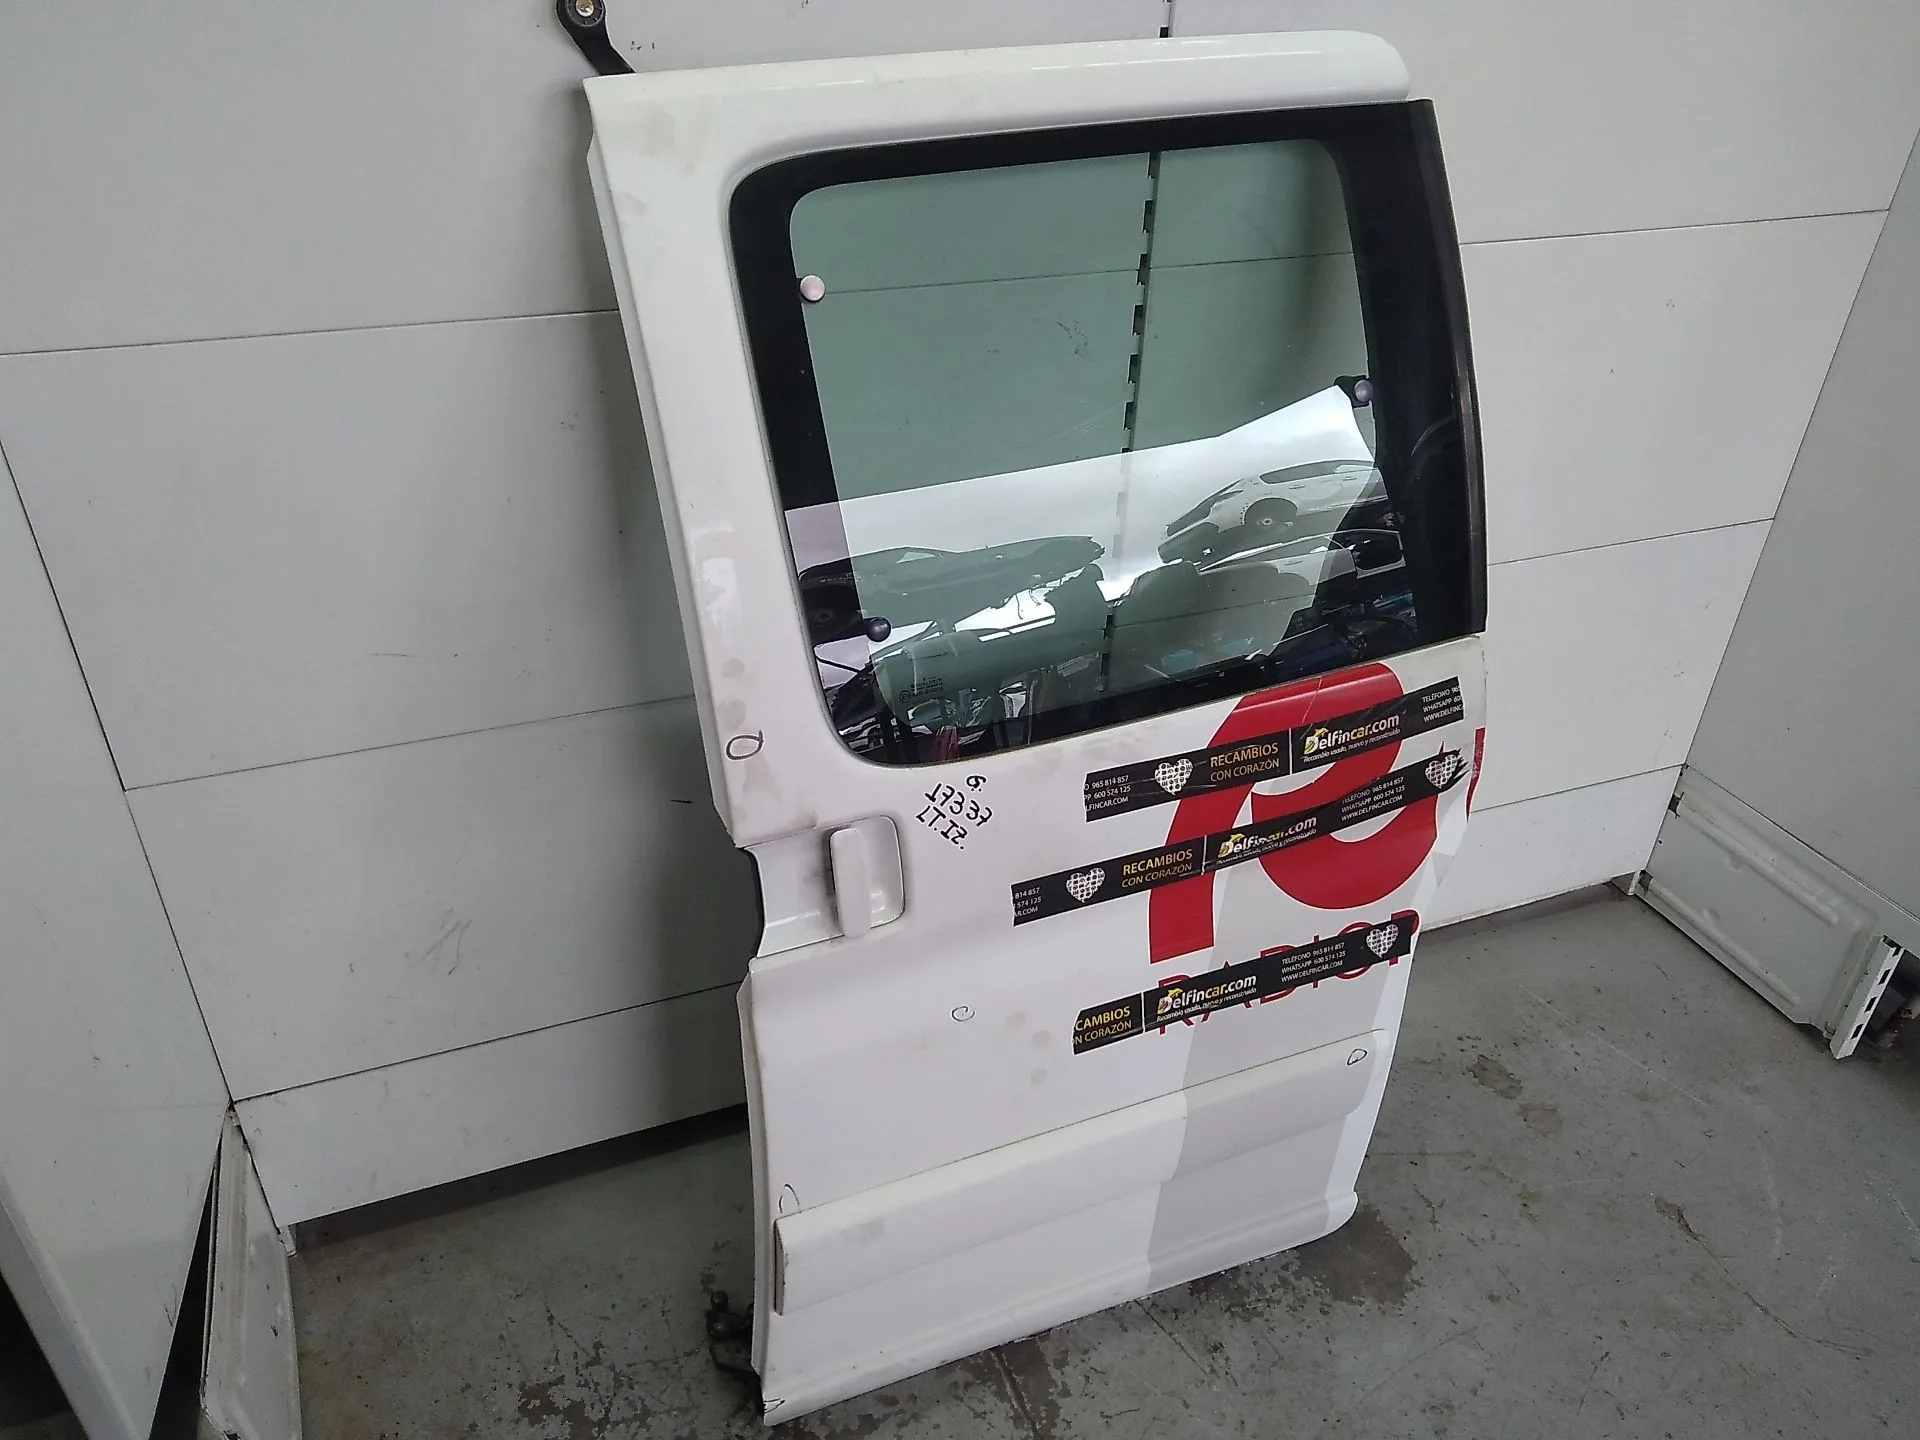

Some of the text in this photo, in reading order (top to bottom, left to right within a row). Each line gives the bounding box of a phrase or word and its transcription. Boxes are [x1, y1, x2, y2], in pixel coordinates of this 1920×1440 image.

[1422, 698, 1452, 712] WHATSAPP
[1303, 750, 1330, 763] Recambio
[1348, 740, 1364, 750] nuevo
[1369, 728, 1400, 744] reconstruido
[1304, 714, 1400, 755] Delfincar.com
[1210, 742, 1279, 768] RECAMBIOS
[1210, 758, 1280, 782] CON CORAZÓN
[1092, 780, 1104, 790] 965
[1104, 778, 1116, 786] 814
[1117, 775, 1130, 784] 857
[1094, 790, 1106, 800] 600
[1106, 788, 1120, 797] 574
[1120, 785, 1131, 794] 125
[1372, 784, 1382, 793] 965
[1383, 780, 1393, 790] 814
[1394, 776, 1404, 785] 857
[1085, 796, 1129, 812] LFINCAR.COM
[1341, 794, 1402, 821] WWW.DELFINCAR.COM
[1342, 784, 1406, 812] WHATSAPP 600 574 125
[1123, 849, 1192, 876] RECAMBIOS
[1122, 862, 1192, 888] CON CORAZÓN
[1015, 887, 1040, 899] 814 857
[1030, 896, 1042, 904] 125
[1324, 945, 1334, 953] 814
[1334, 942, 1344, 950] 857
[1281, 960, 1343, 982] WWW.DELFINCAR.COM
[1282, 960, 1312, 974] WHATSAPP
[1314, 956, 1324, 964] 600
[1336, 950, 1346, 958] 125
[1157, 976, 1257, 1014] Delfincar.com
[1076, 1006, 1130, 1032] CAMBIOS
[1084, 1019, 1132, 1042] CORAZÓN
